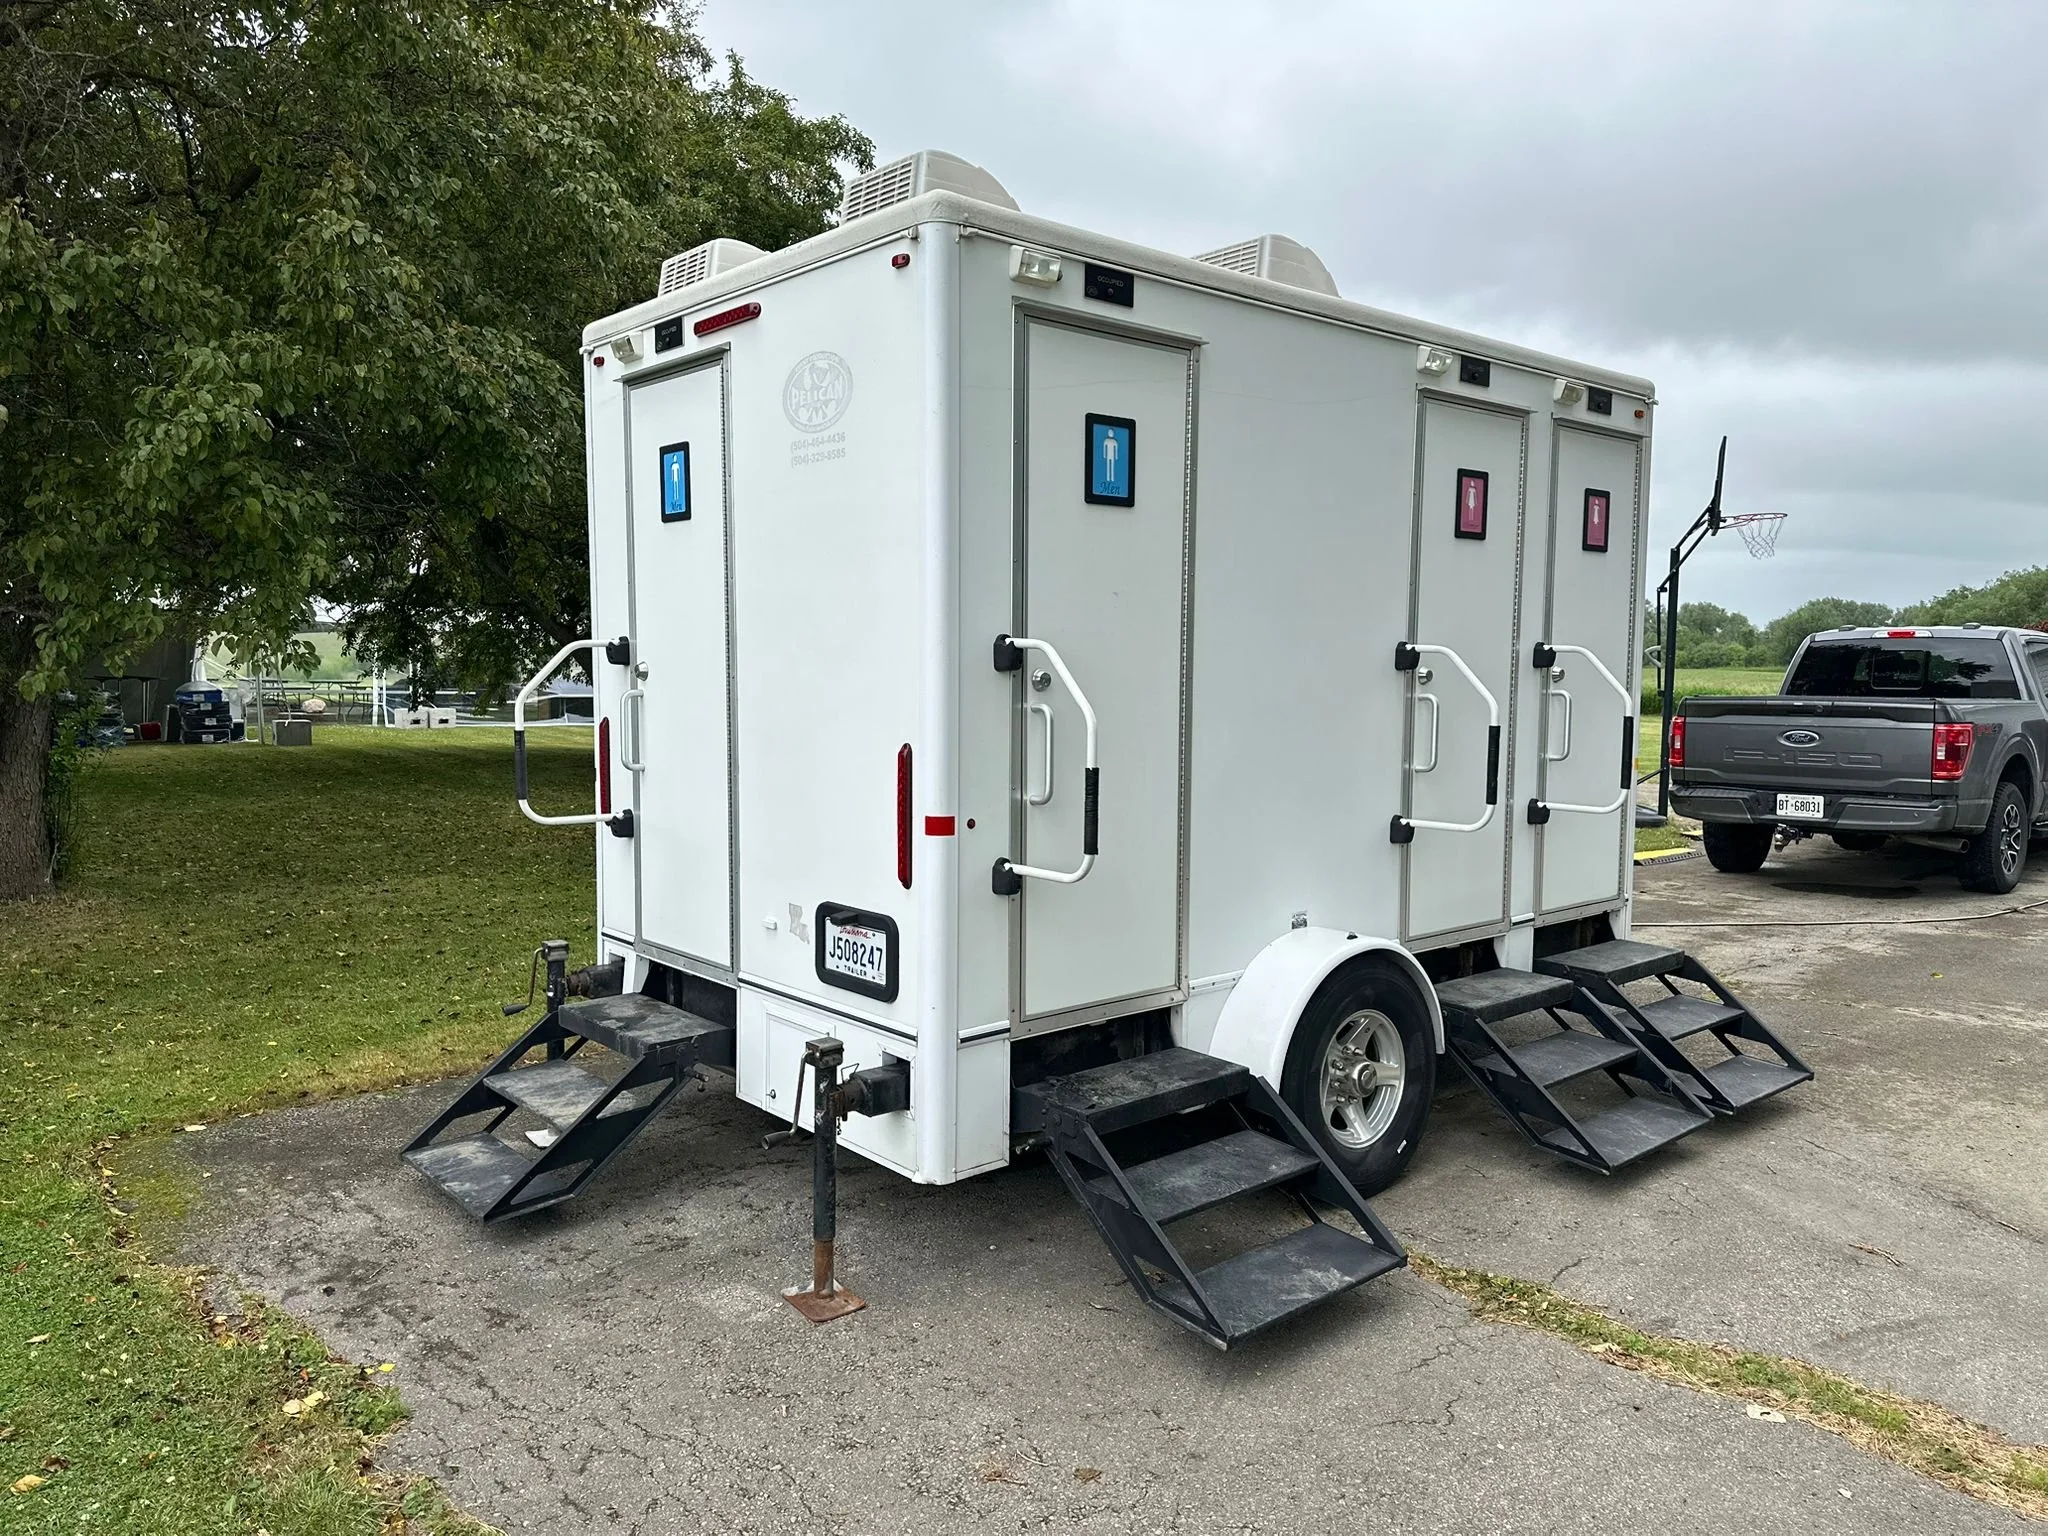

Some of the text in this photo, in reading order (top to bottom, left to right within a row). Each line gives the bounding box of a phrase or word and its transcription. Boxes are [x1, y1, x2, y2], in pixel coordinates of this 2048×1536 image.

[791, 375, 844, 410] PELICAN
[1100, 481, 1120, 495] Men
[1790, 733, 1811, 743] Ford
[1723, 747, 1883, 769] F-150
[1794, 800, 1820, 813] 68031
[829, 936, 883, 972] J508247
[844, 964, 867, 977] TRAILER
